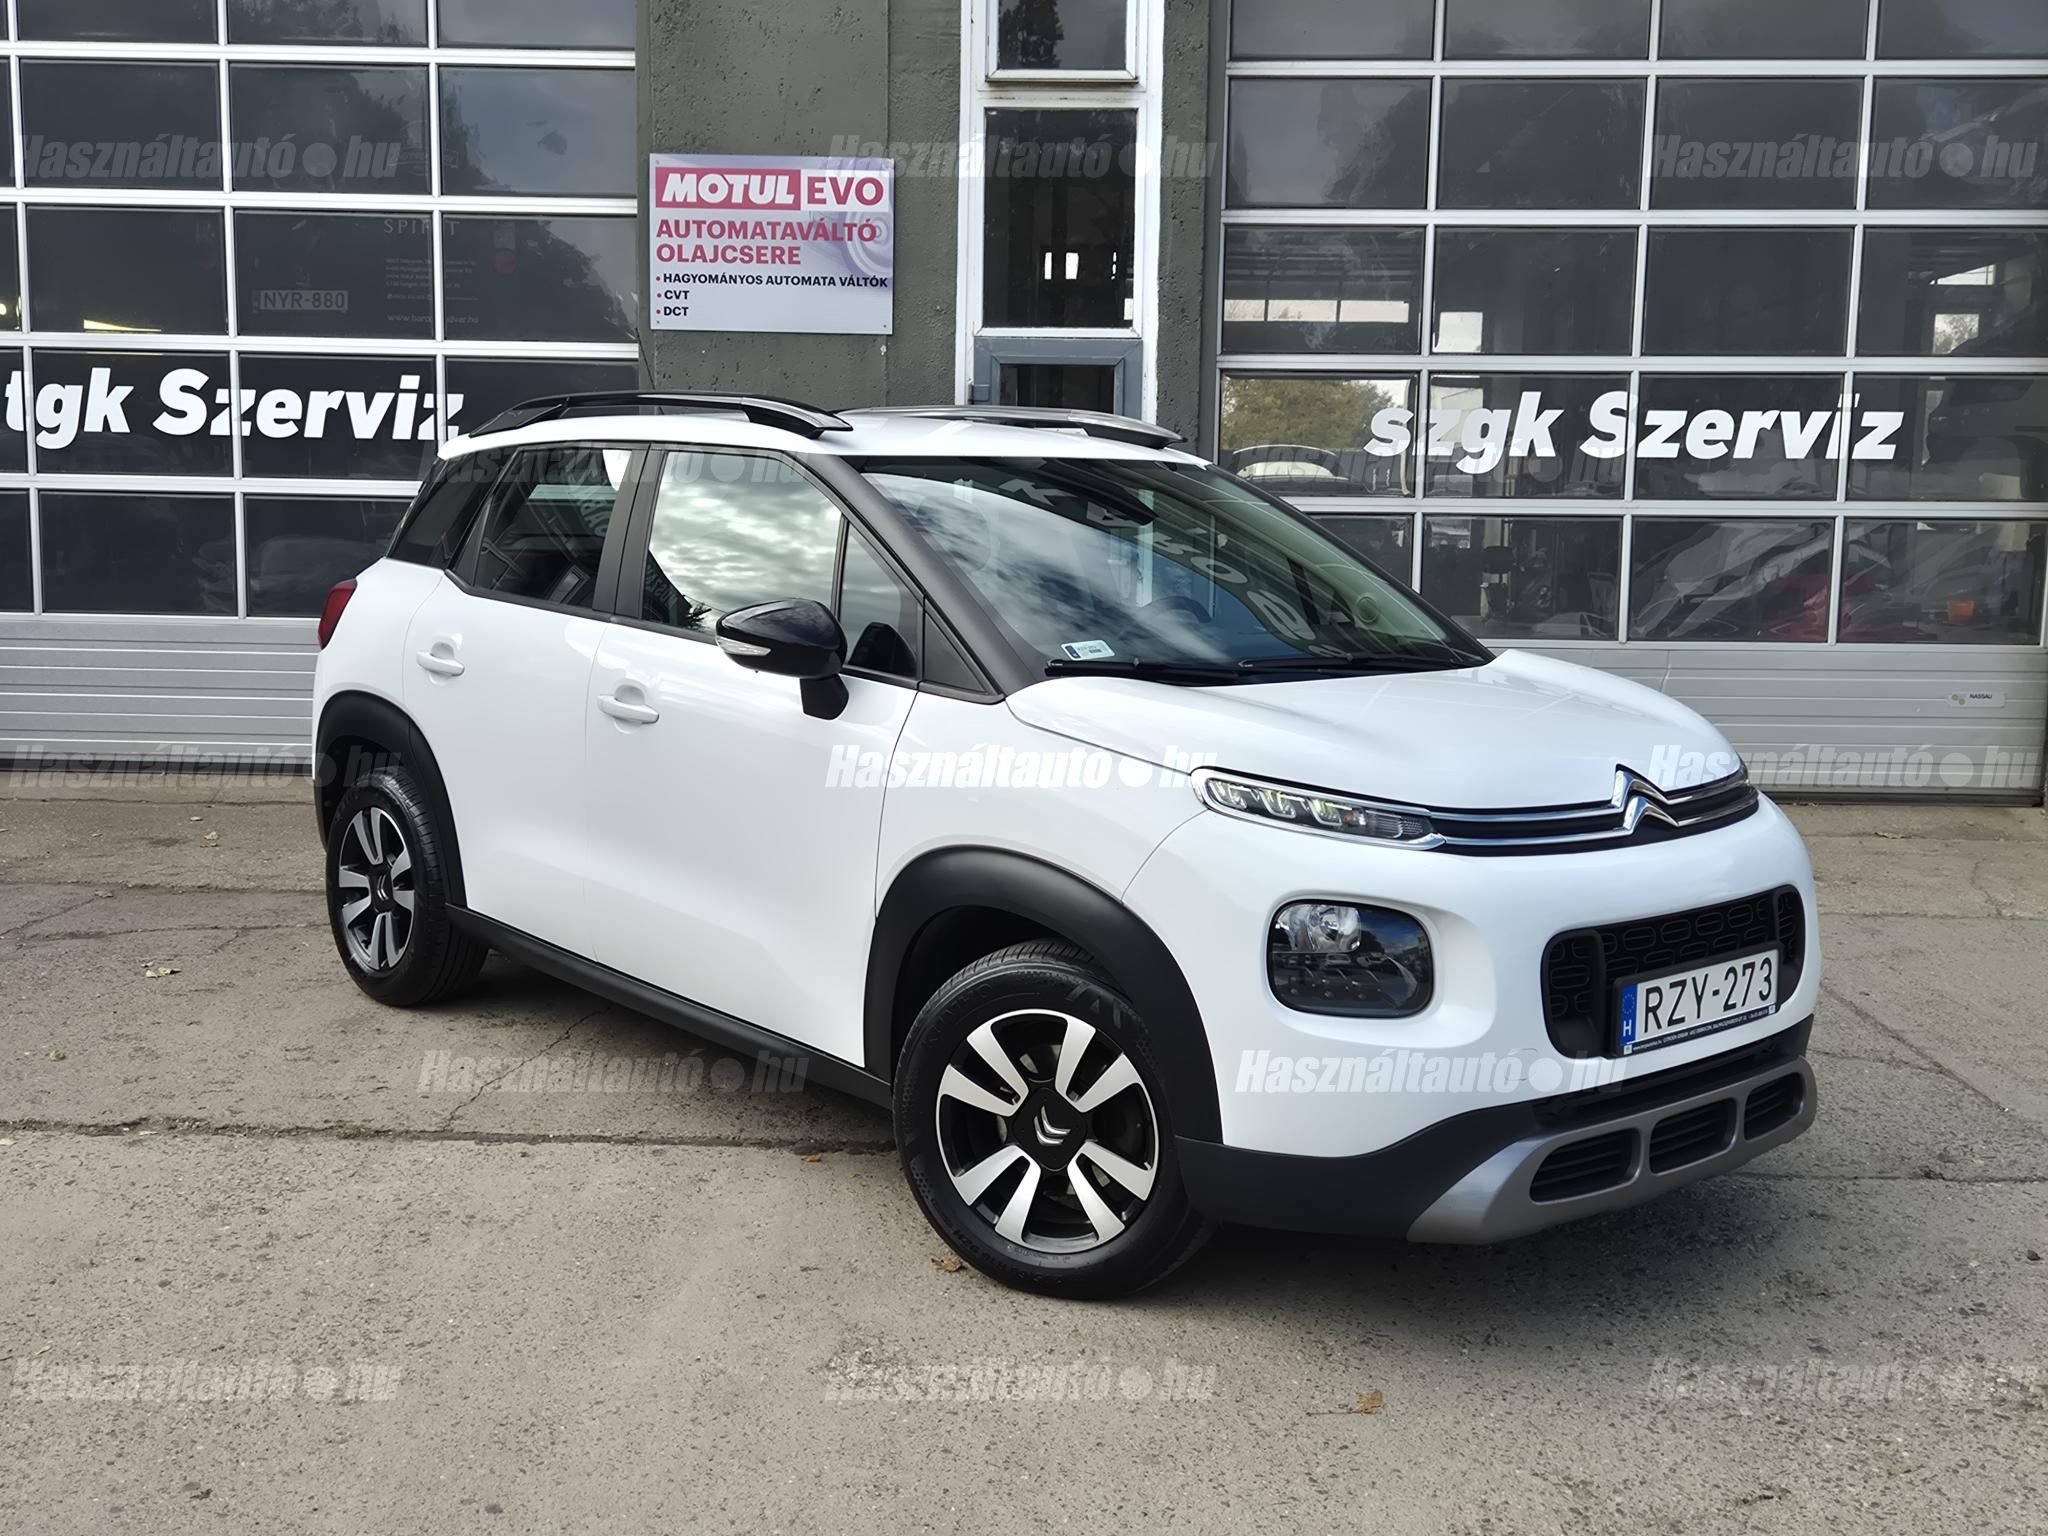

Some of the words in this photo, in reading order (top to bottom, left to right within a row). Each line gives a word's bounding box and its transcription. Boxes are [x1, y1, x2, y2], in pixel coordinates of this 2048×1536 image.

[661, 172, 795, 205] MOTUL
[807, 176, 884, 206] EVO
[656, 217, 877, 242] AUTOMATAVÁLTÓ
[656, 243, 801, 265] OLAJCSERE
[663, 272, 763, 286] HAGYOMÁNYOS
[766, 275, 836, 287] AUTOMATA
[839, 274, 888, 288] VÁLTÓK
[263, 290, 346, 309] NYR-880
[664, 290, 690, 300] CVT
[663, 306, 689, 317] DCT
[152, 367, 465, 442] Szerviz
[1363, 391, 1564, 474] szgk
[1579, 391, 1905, 460] Szerviz
[1644, 957, 1773, 1033] RZY-273
[1623, 1019, 1632, 1037] H
